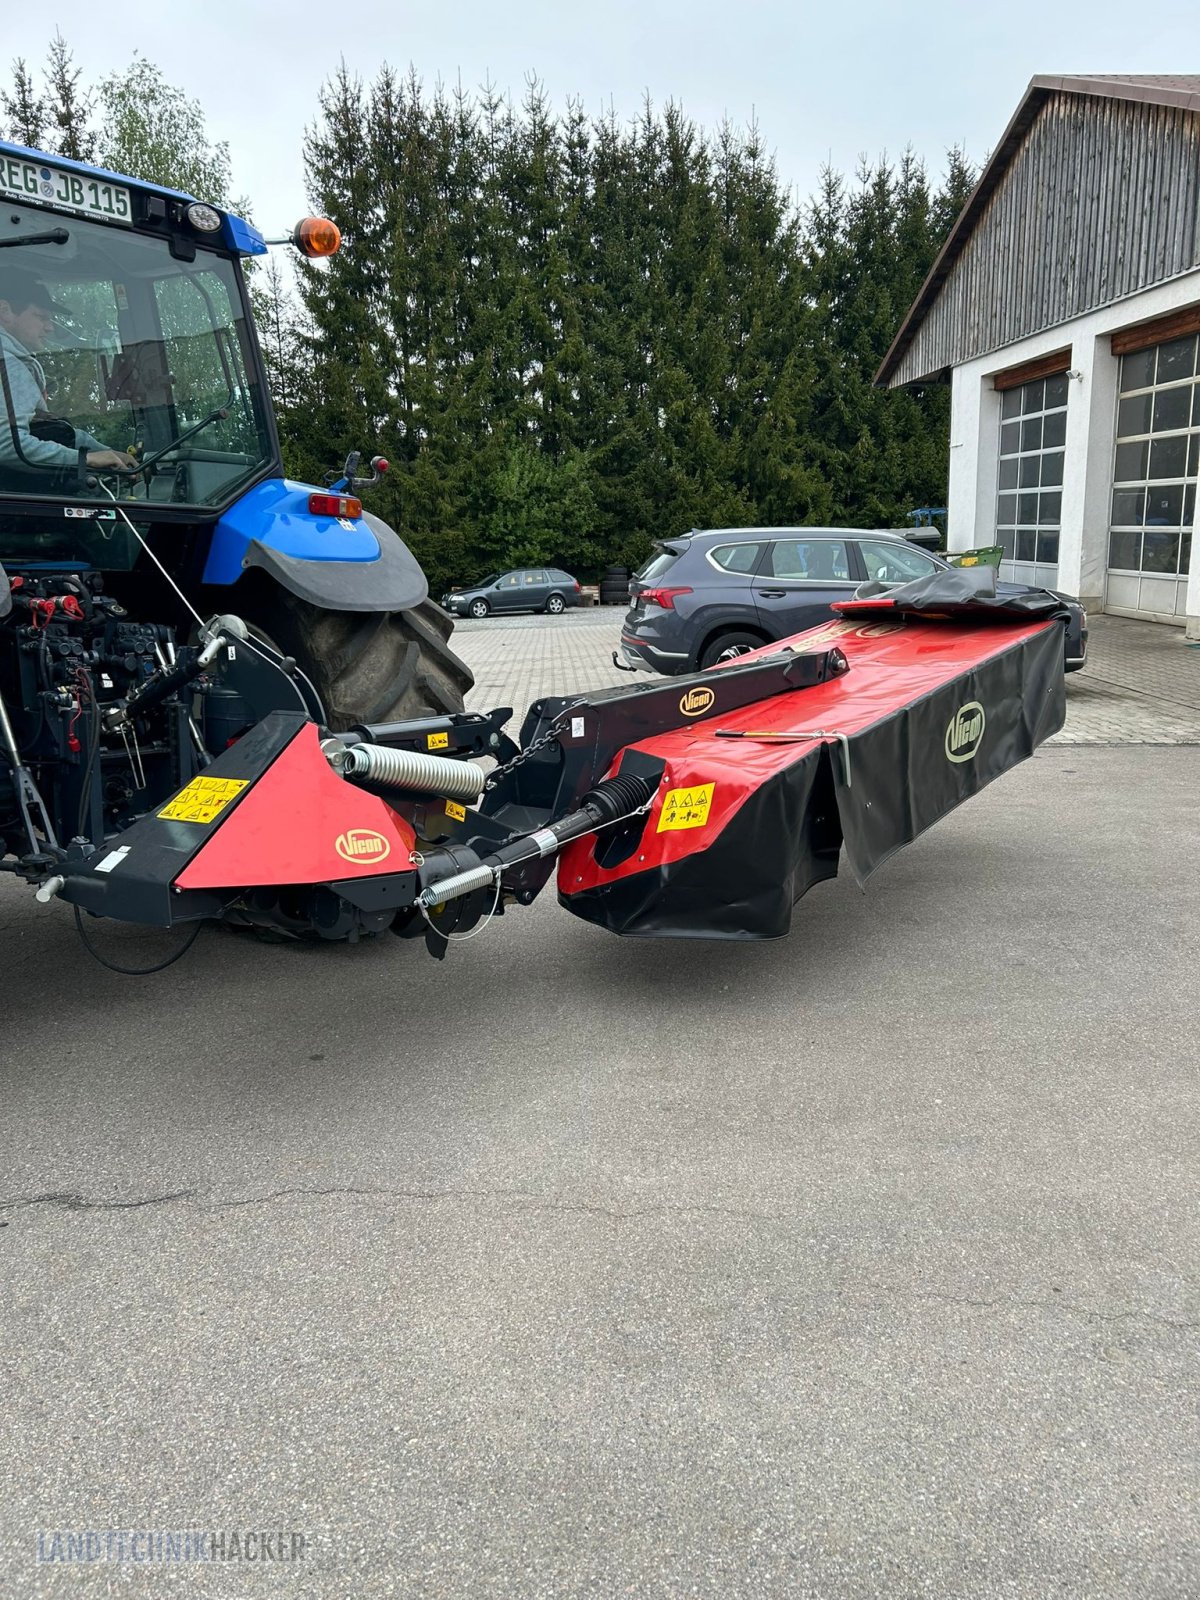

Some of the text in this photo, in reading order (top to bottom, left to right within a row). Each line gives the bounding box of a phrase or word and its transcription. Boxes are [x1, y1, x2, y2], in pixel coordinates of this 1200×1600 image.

[57, 174, 84, 205] JB
[88, 182, 127, 216] 115
[679, 686, 715, 717] Vicon
[944, 701, 986, 763] Vicon
[335, 828, 391, 865] Vicon
